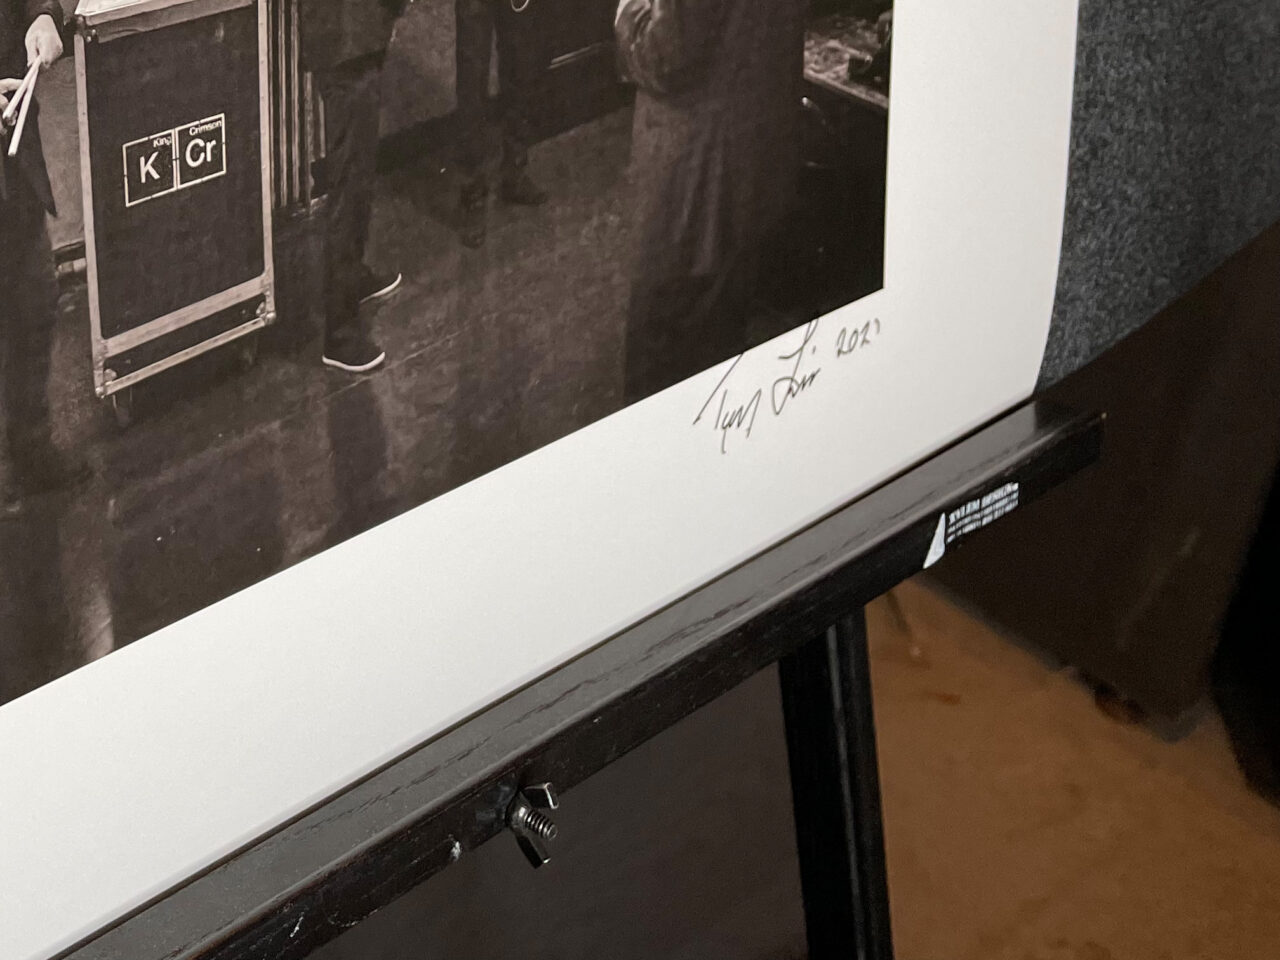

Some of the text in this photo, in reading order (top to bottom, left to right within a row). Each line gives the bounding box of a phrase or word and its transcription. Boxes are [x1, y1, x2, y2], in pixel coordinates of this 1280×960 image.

[152, 120, 222, 148] King Crimson
[139, 138, 217, 184] K Cr
